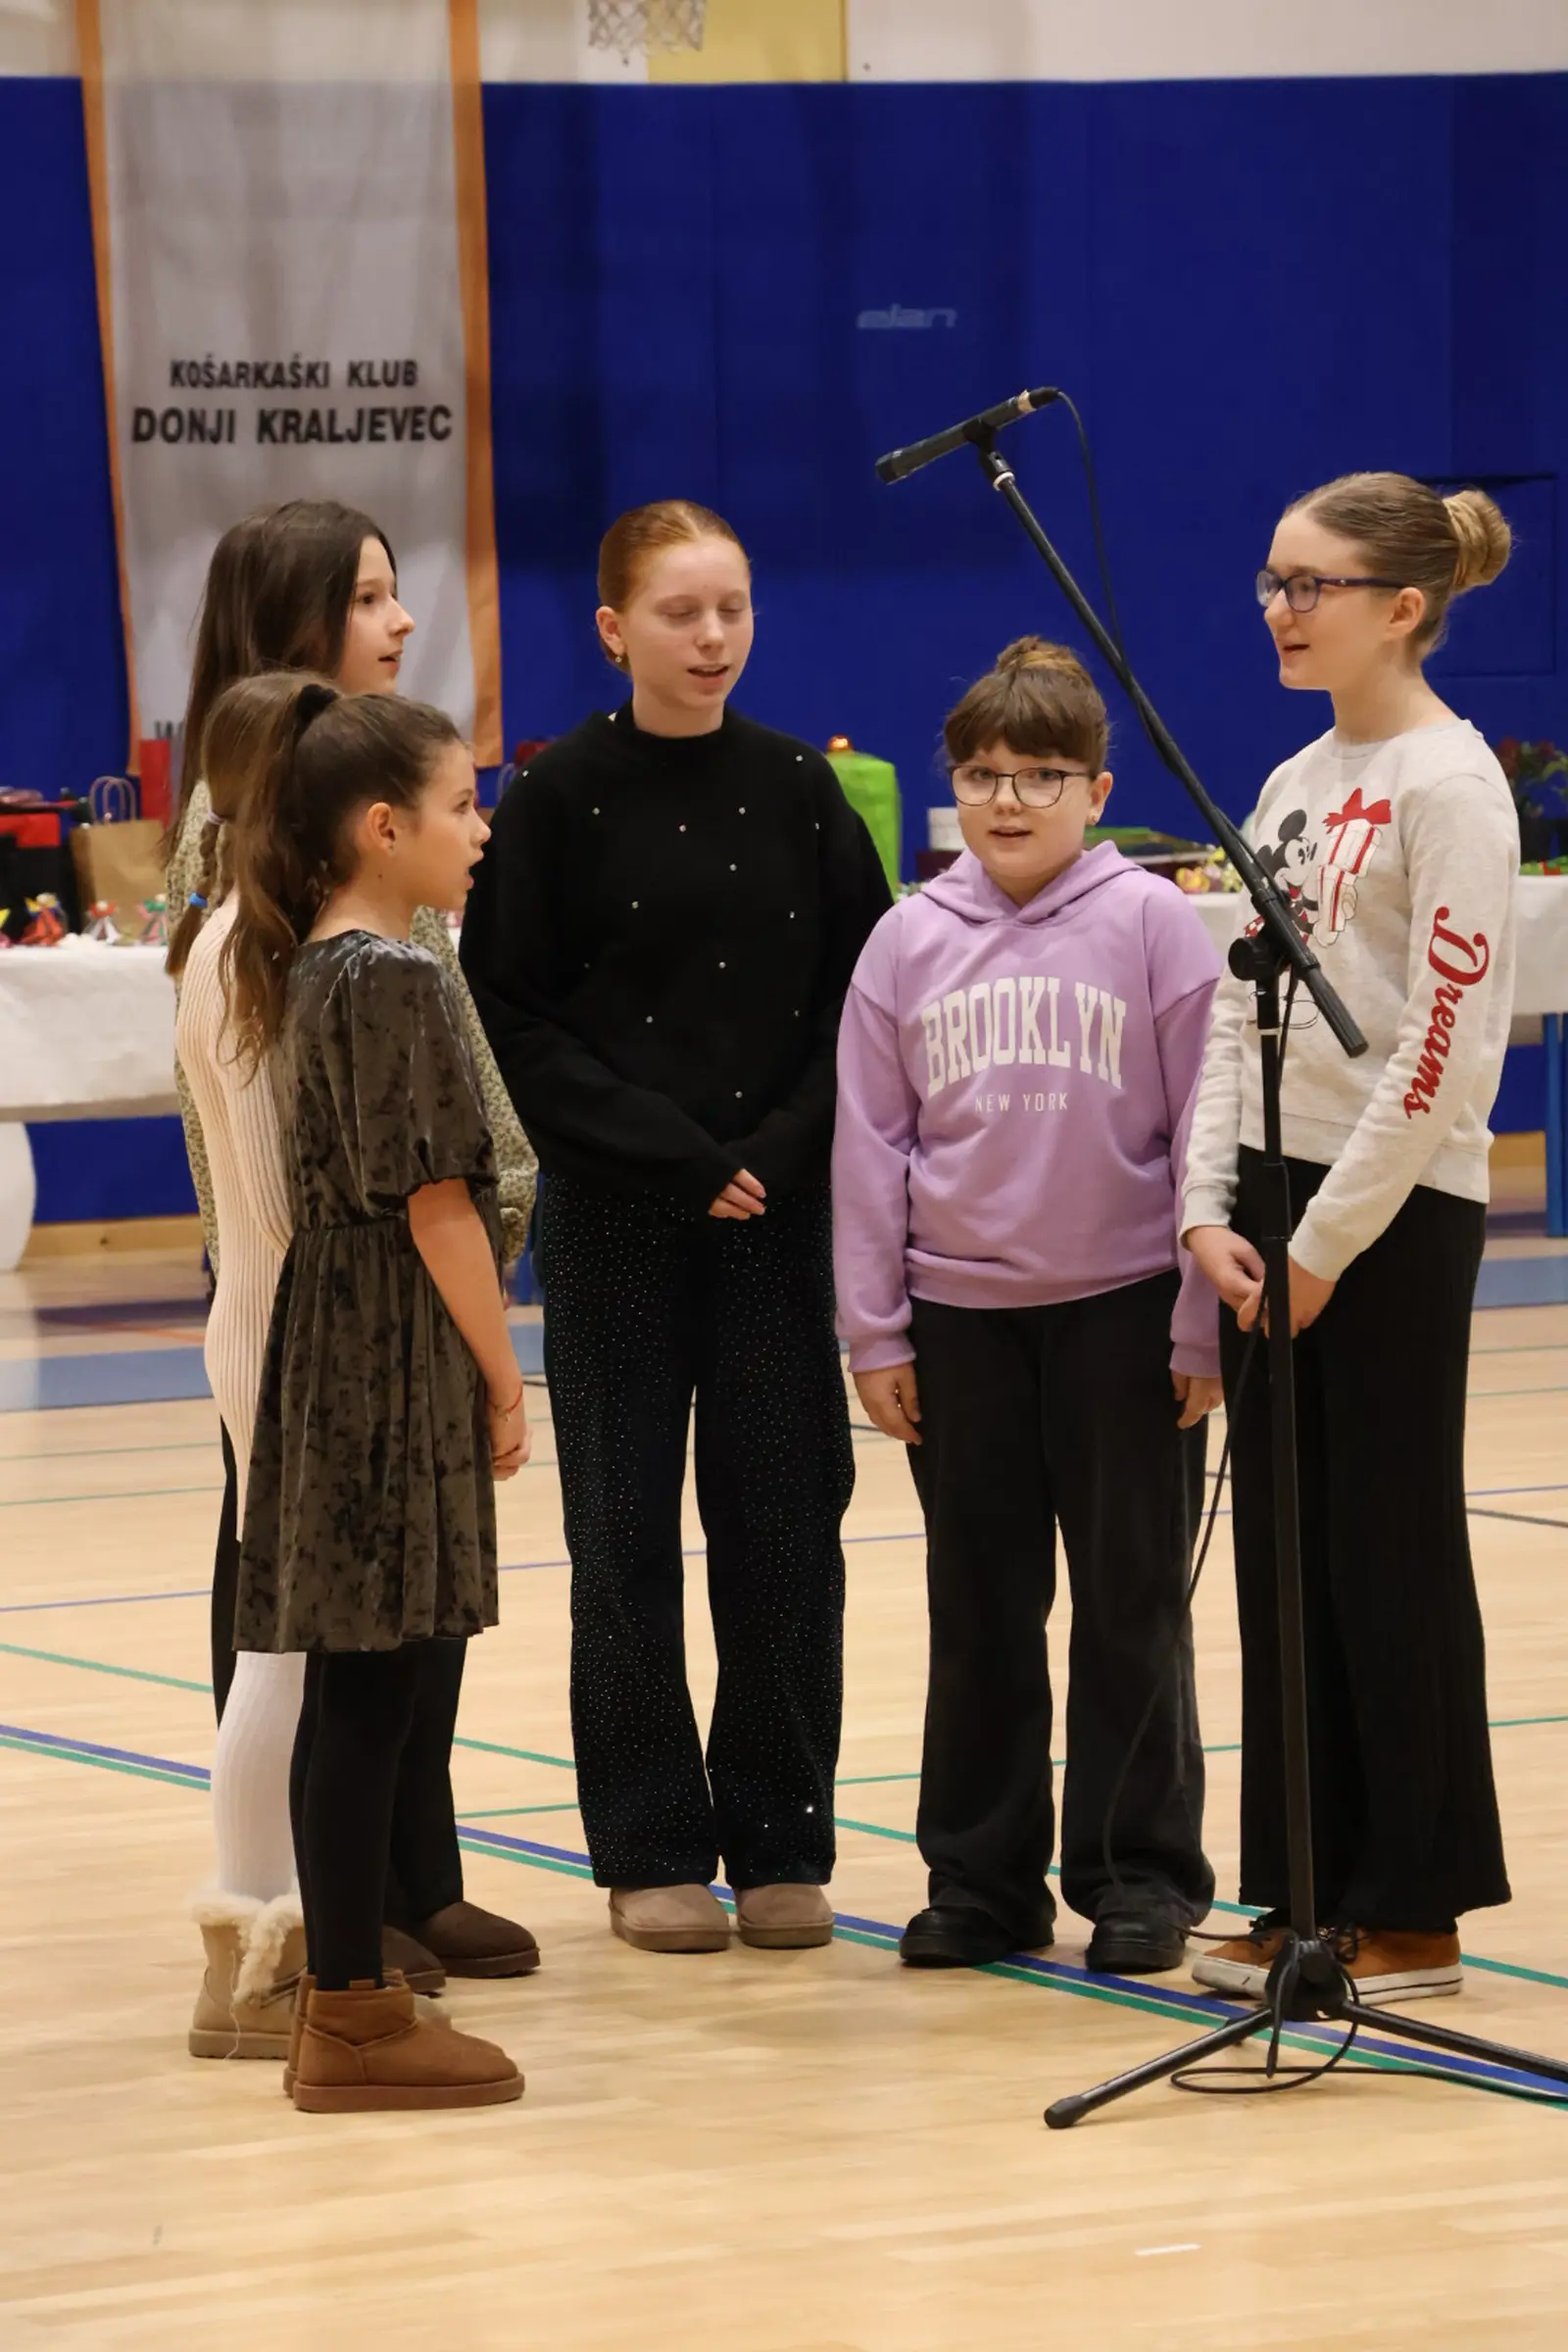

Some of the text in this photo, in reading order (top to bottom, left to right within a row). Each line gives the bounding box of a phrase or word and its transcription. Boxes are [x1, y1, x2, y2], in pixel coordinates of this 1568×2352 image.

[348, 360, 417, 387] KLUB
[132, 405, 453, 443] DONJI KRALJEVEC
[1403, 906, 1490, 1119] Dreams
[921, 976, 1126, 1100] BROOKLYN
[975, 1093, 1068, 1112] NEW YORK
